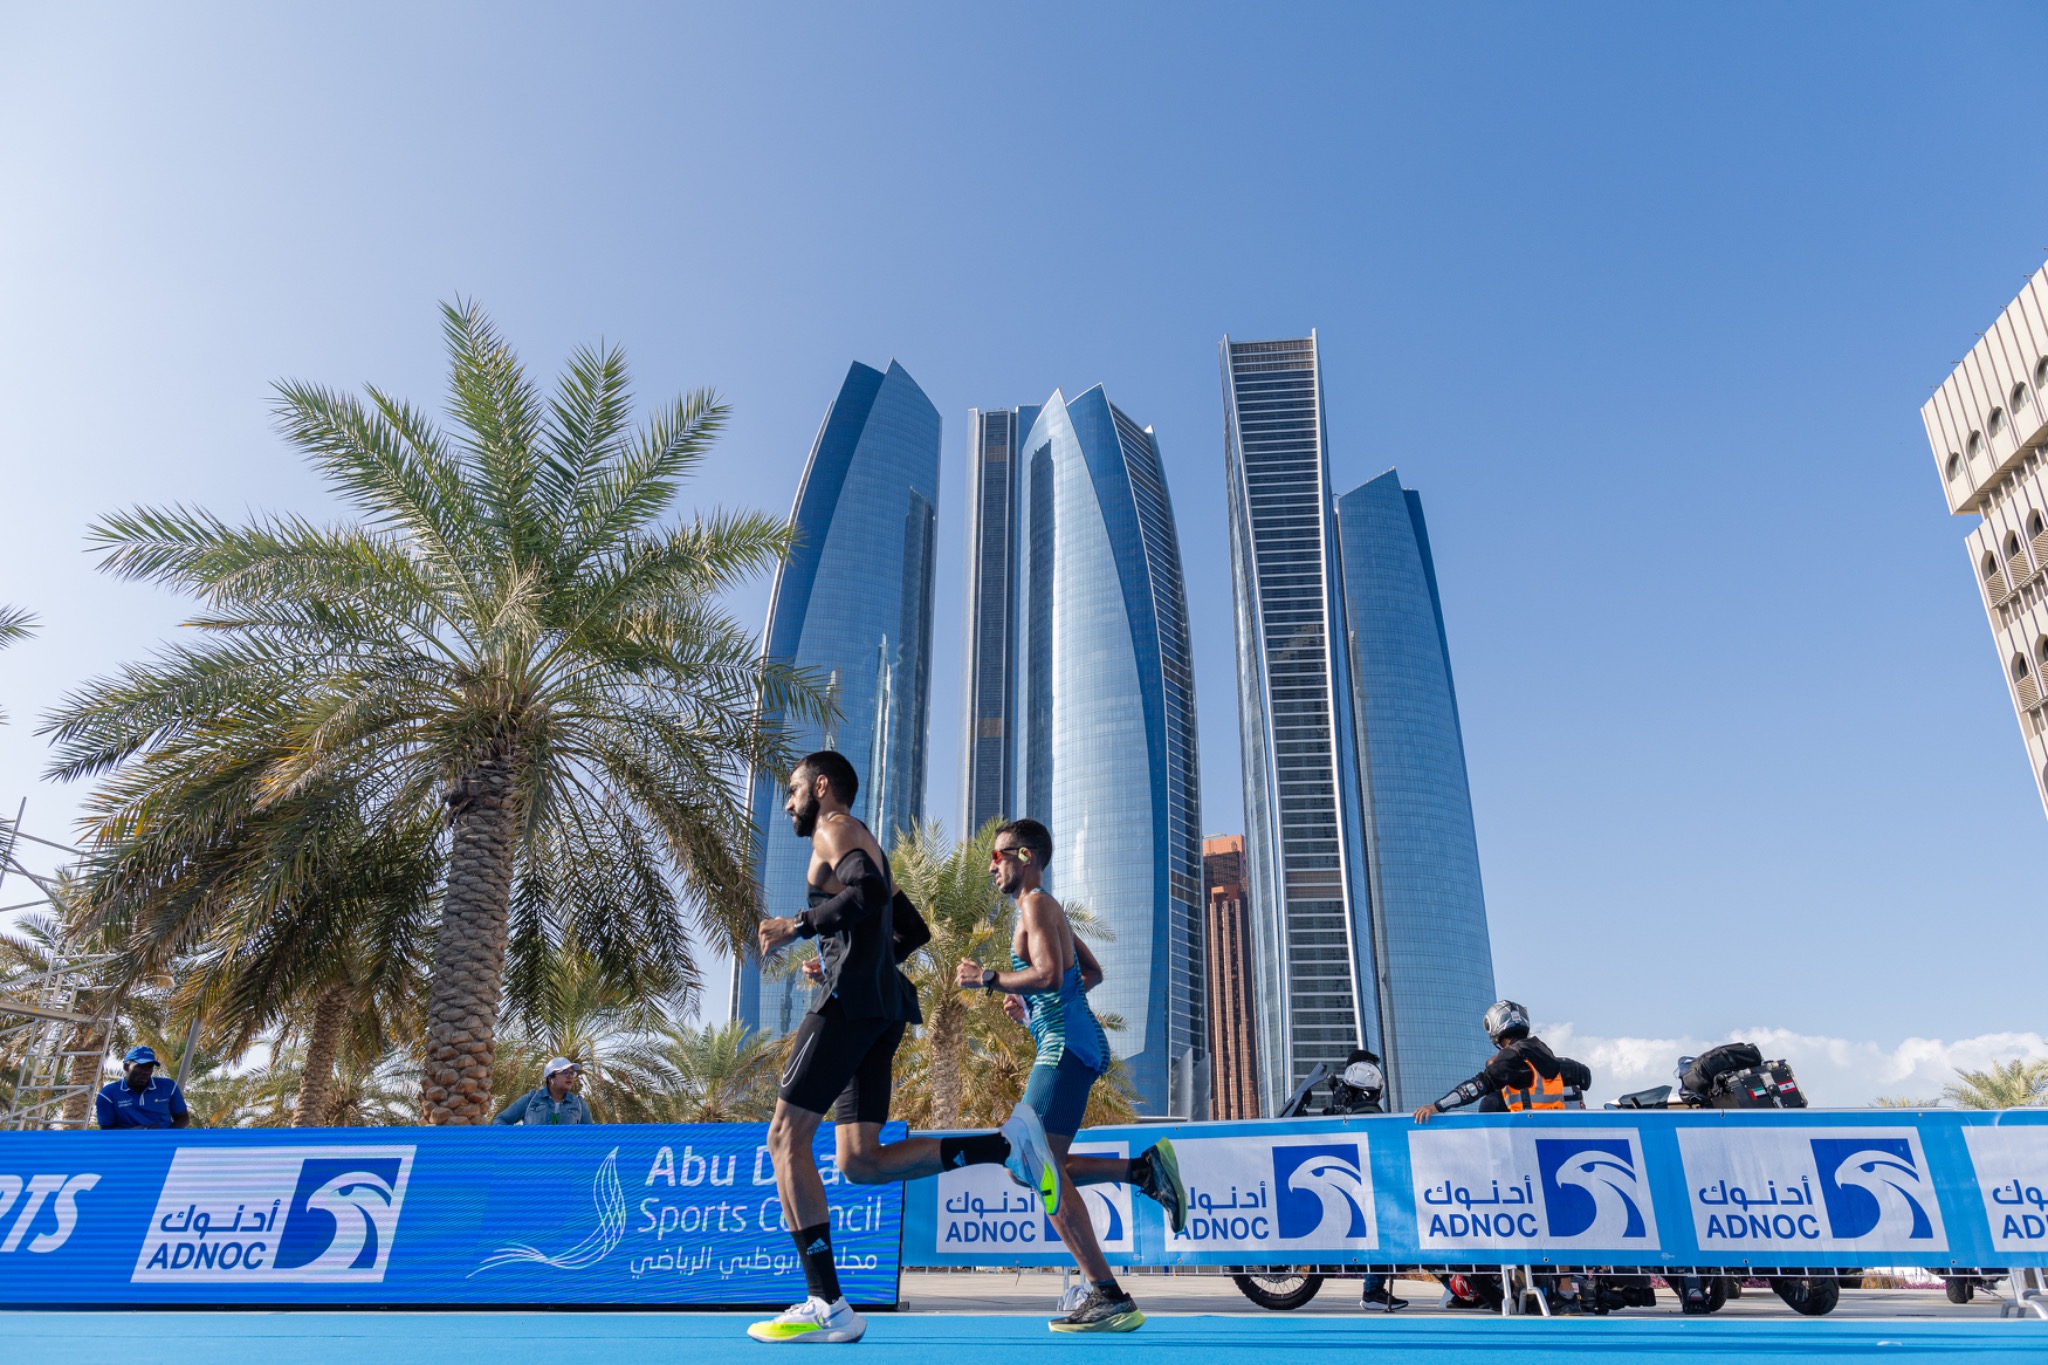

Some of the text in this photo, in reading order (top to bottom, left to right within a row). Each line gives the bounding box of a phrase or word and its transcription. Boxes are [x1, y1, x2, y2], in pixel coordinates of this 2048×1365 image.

[644, 1145, 737, 1187] Abu
[945, 1185, 1036, 1220] أدنوك
[1423, 1174, 1534, 1212] أدنوك
[1698, 1174, 1814, 1213] أدنوك
[160, 1198, 281, 1241] أدنوك
[637, 1197, 748, 1241] Sports
[944, 1220, 1037, 1243] ADNOC
[1428, 1212, 1539, 1238] ADNOC
[1706, 1213, 1821, 1240] ADNOC
[2002, 1213, 2048, 1240] AD
[145, 1241, 267, 1270] ADNOC
[833, 1245, 878, 1276] مجل
